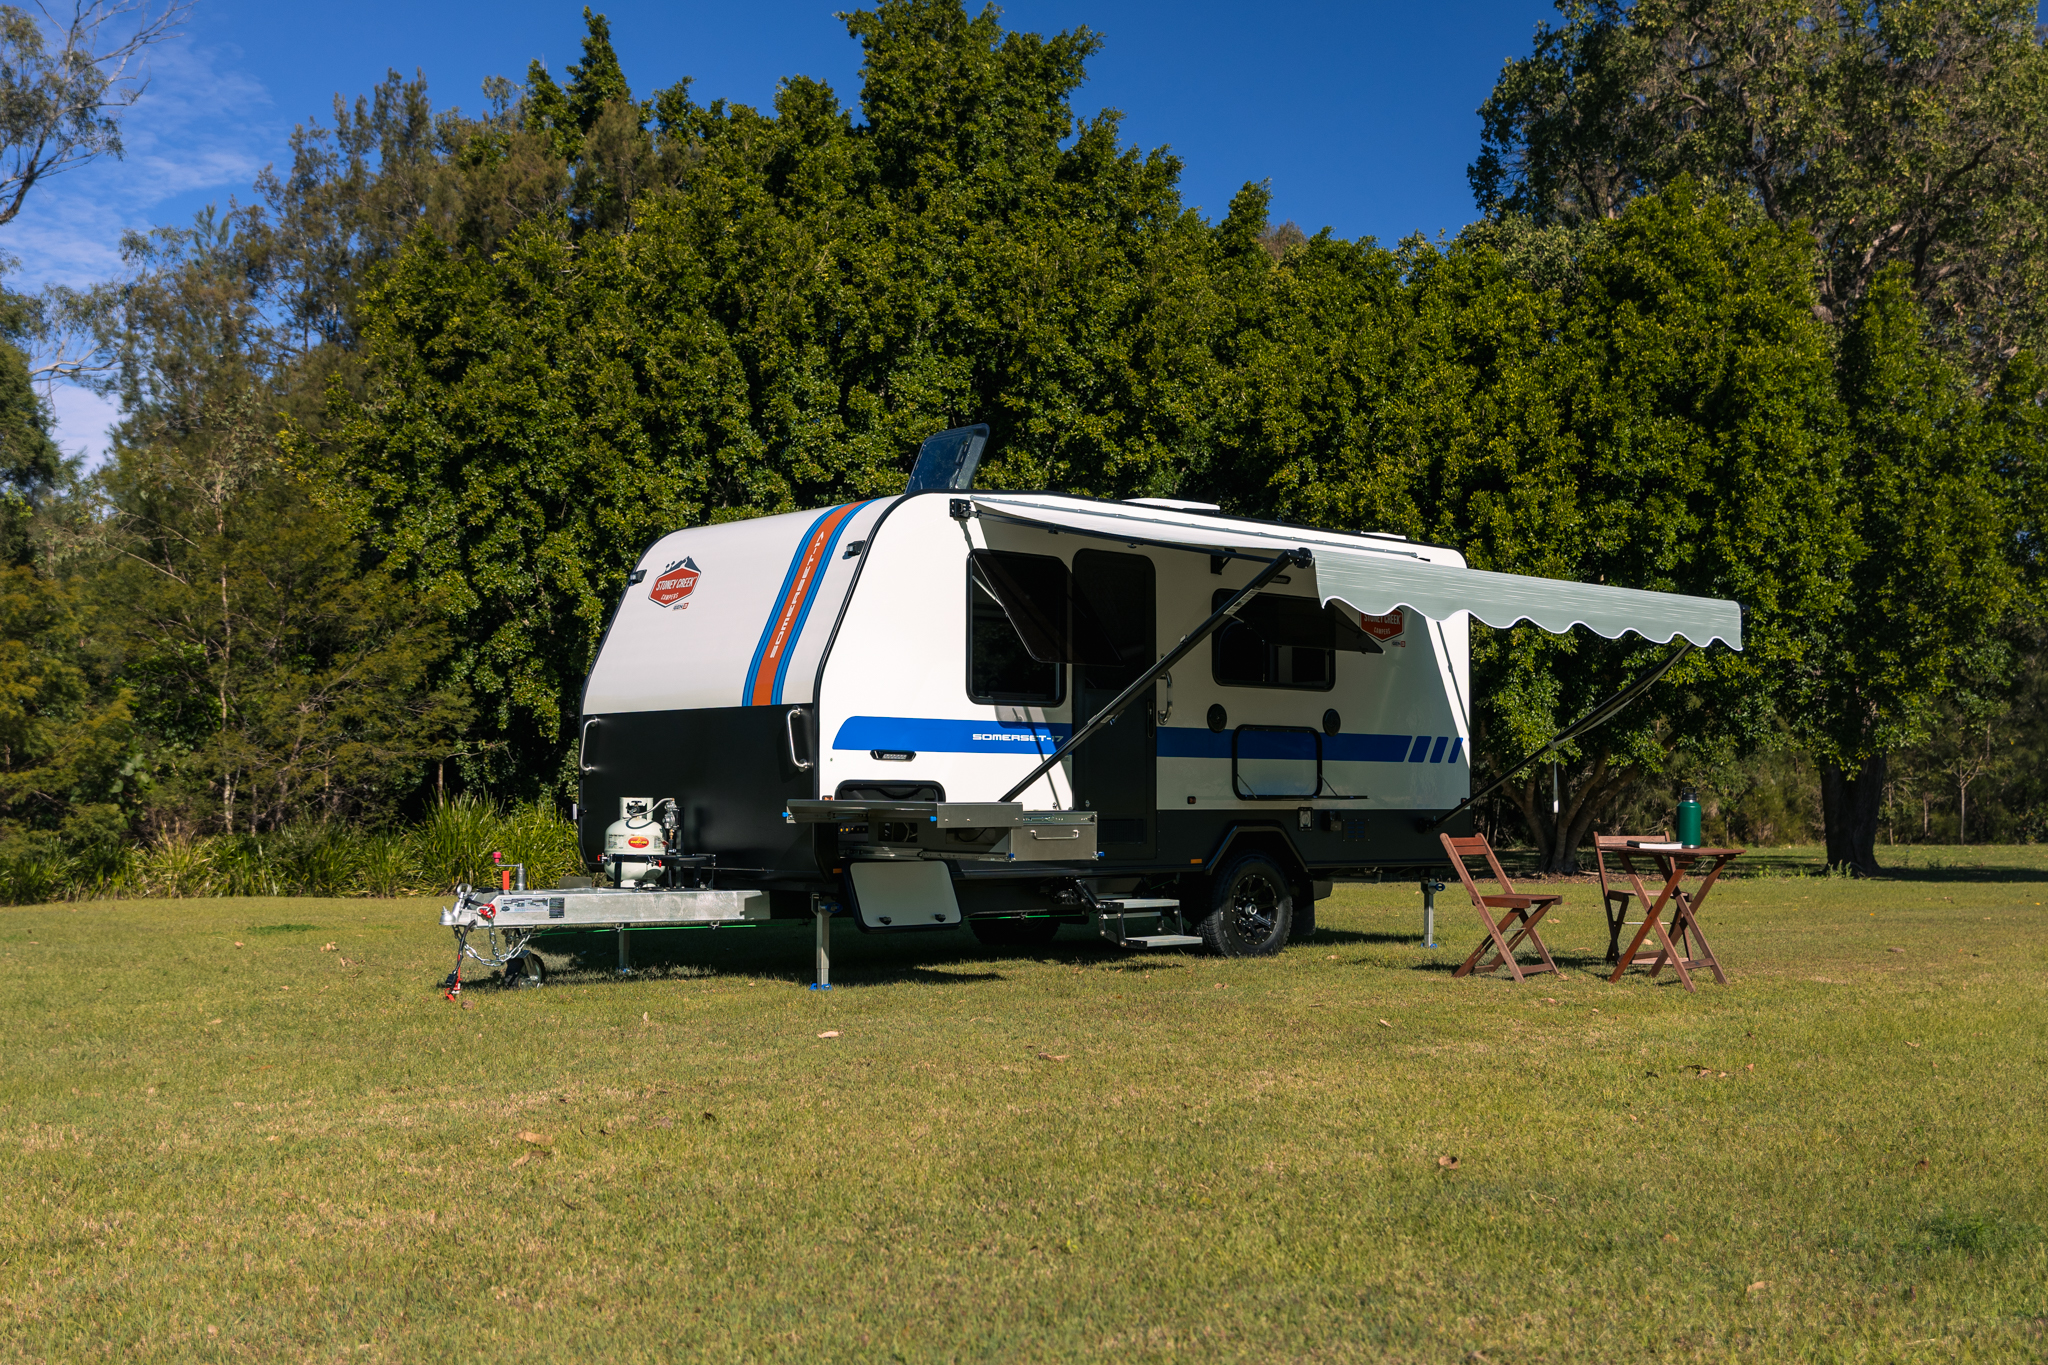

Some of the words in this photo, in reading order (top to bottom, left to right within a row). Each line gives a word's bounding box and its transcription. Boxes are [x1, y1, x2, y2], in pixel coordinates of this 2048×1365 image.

[656, 579, 677, 591] STONEY
[676, 576, 696, 589] CREEK
[769, 531, 824, 658] SOMERSET-17
[1384, 614, 1401, 625] CREEK
[972, 733, 1064, 742] SOMERSET-17
